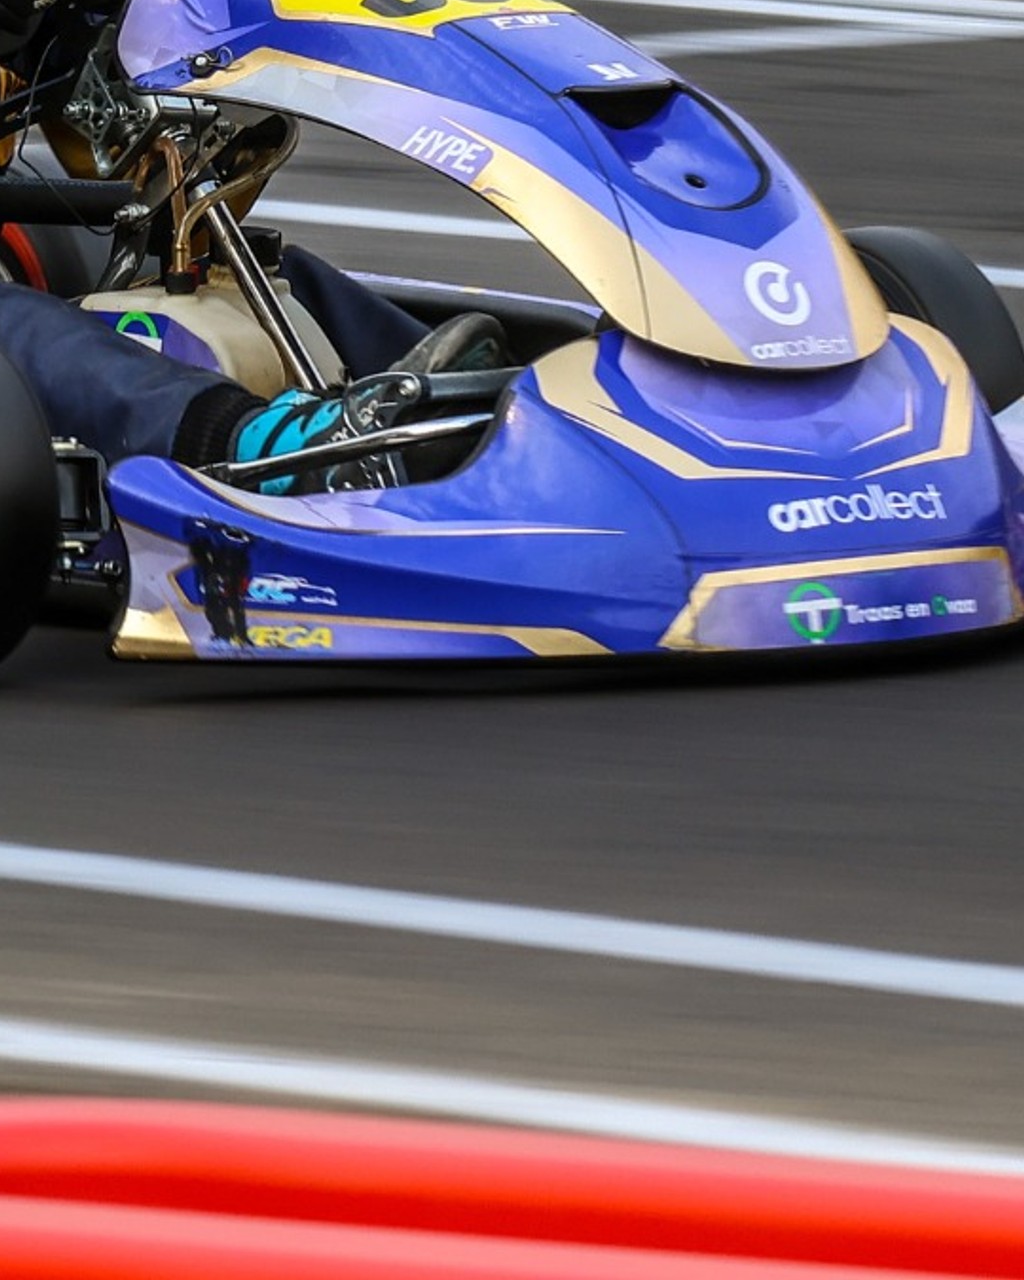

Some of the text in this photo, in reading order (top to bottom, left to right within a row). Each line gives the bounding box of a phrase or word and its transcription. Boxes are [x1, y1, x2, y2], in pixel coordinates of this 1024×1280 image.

[750, 335, 851, 360] carcollect
[768, 483, 947, 533] carcollect
[904, 602, 930, 618] en
